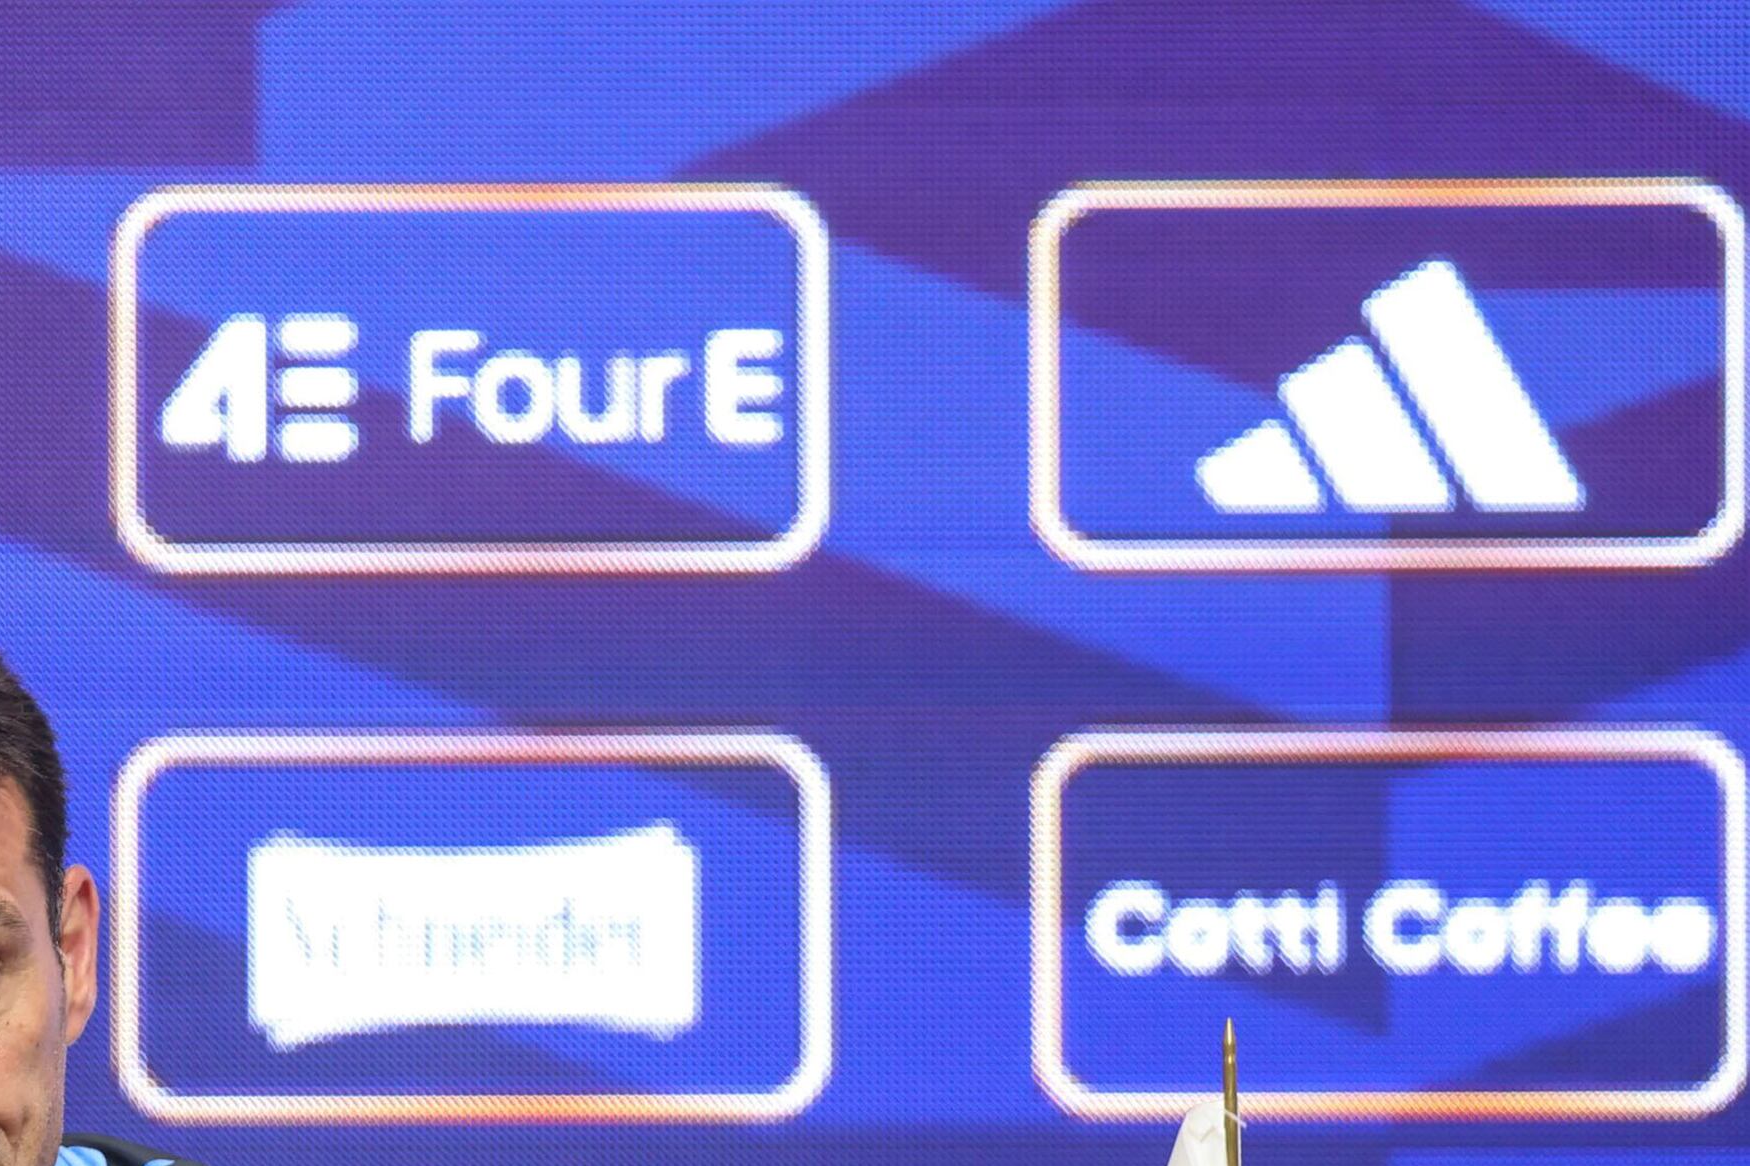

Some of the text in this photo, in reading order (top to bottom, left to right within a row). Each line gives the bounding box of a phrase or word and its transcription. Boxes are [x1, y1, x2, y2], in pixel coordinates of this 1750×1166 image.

[407, 328, 690, 446] Four
[704, 328, 784, 446] E
[1083, 879, 1716, 975] Cotti Coffee
